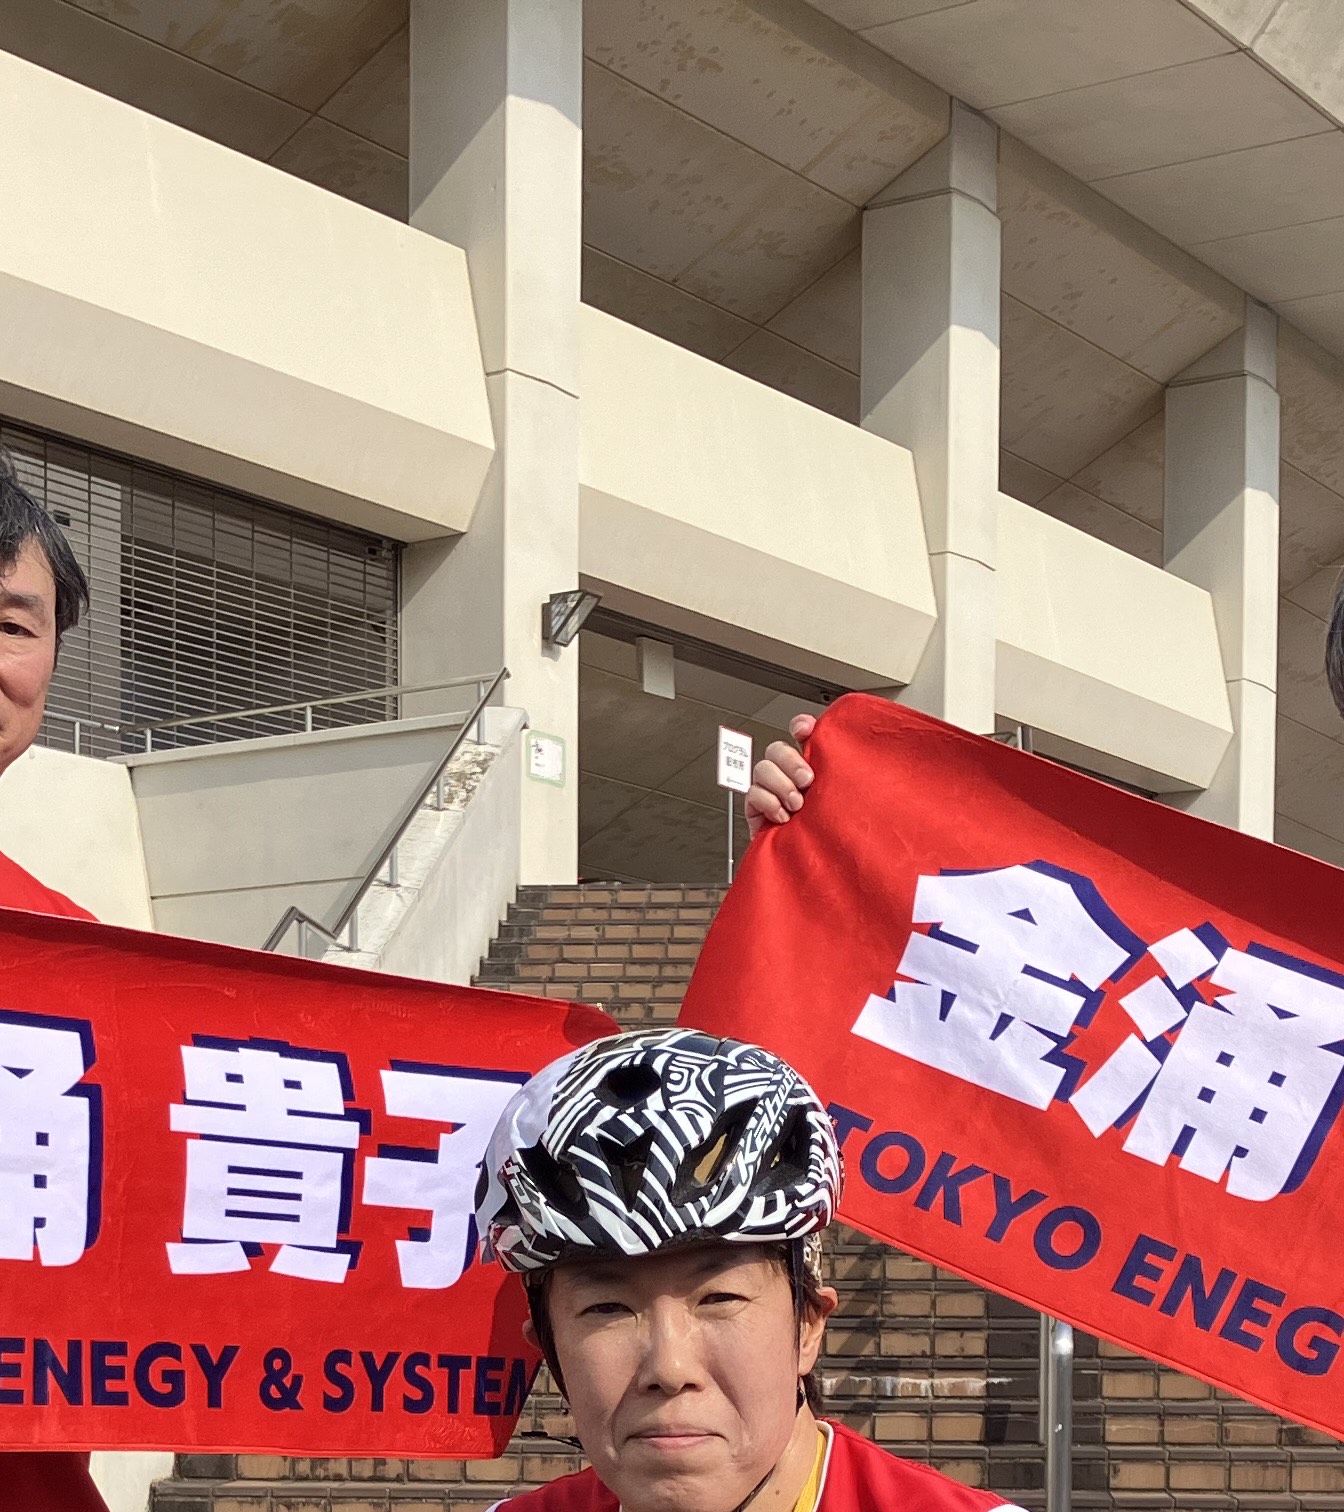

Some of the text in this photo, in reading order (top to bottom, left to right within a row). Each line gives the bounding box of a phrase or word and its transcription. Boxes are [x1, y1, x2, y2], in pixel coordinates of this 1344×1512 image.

[166, 1036, 524, 1290] 貴子
[824, 1101, 1102, 1271] TOKYO
[258, 1347, 304, 1412] &
